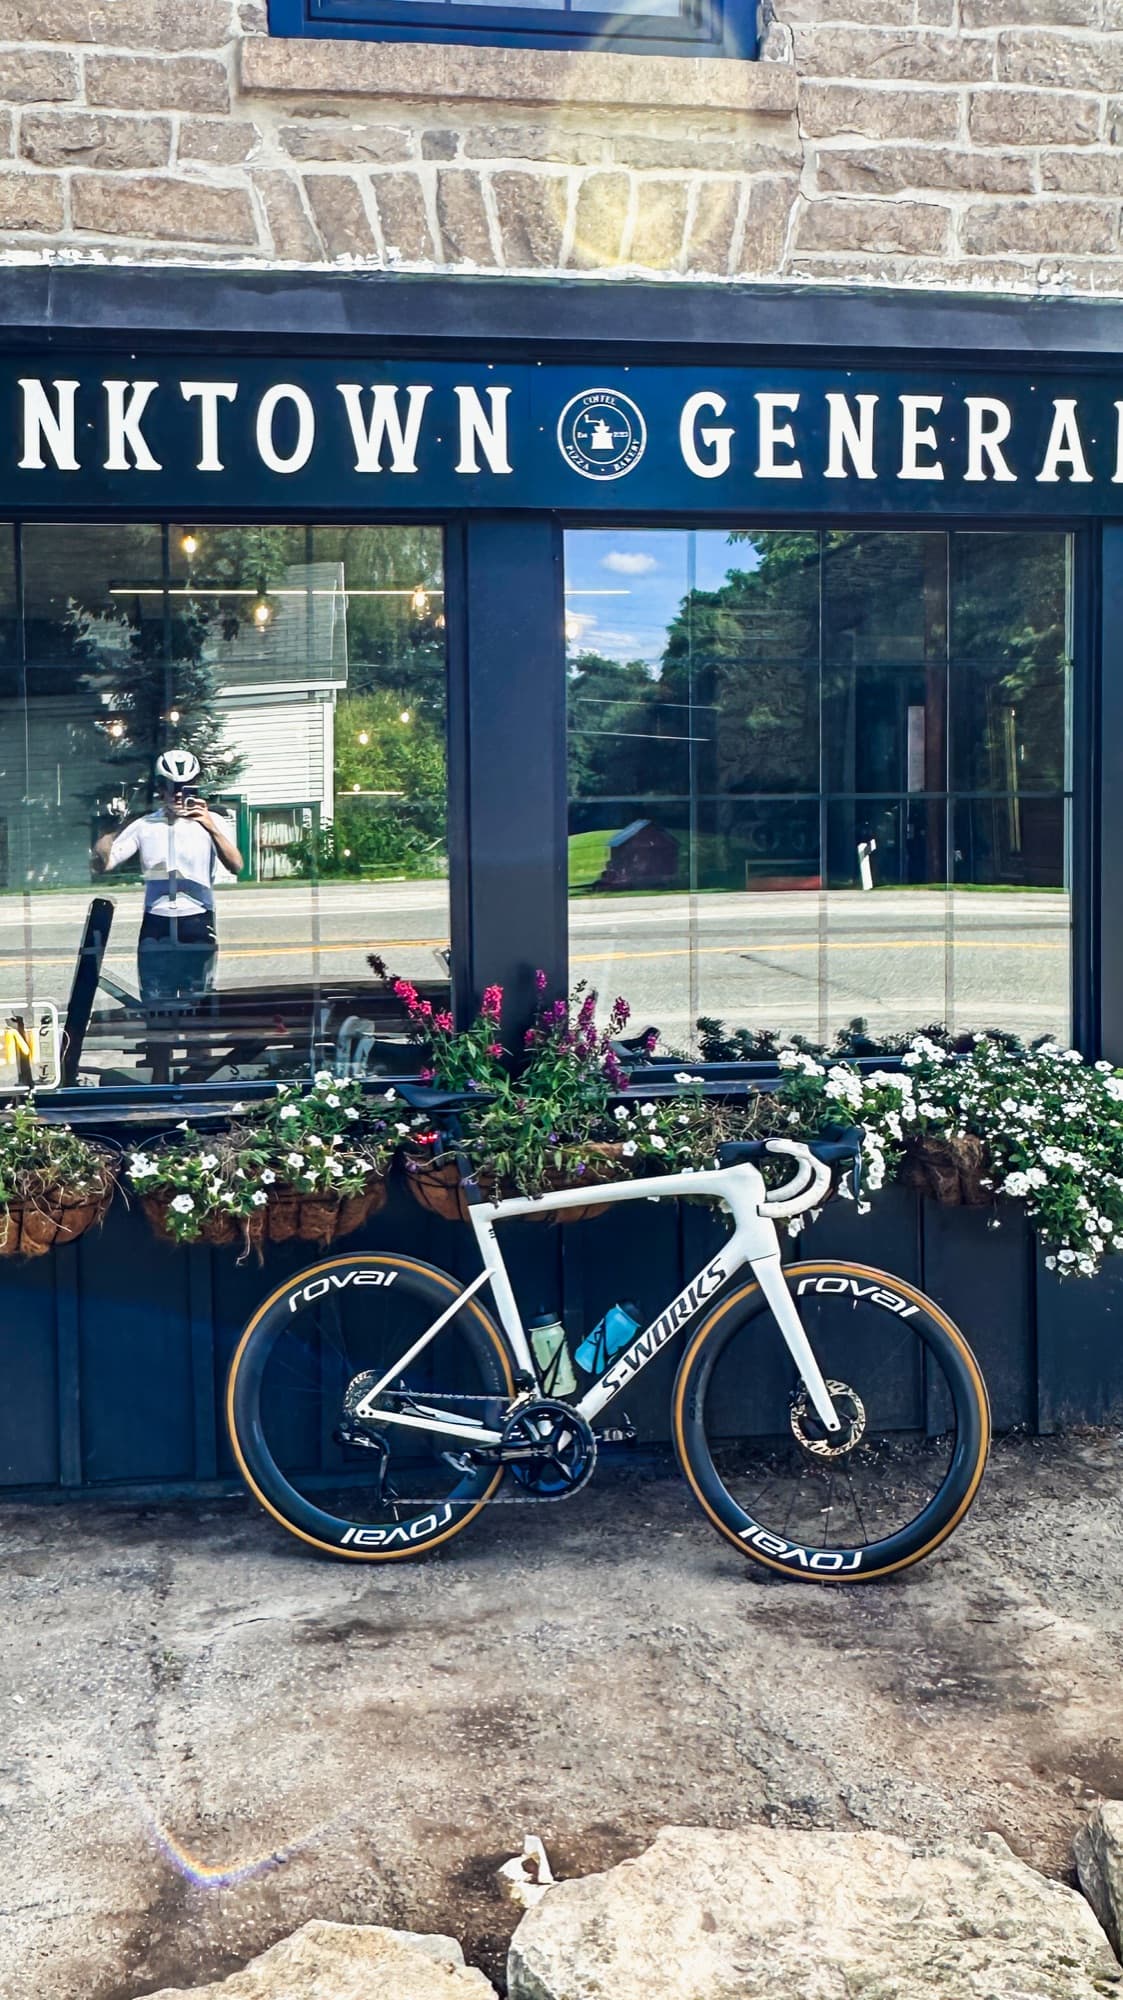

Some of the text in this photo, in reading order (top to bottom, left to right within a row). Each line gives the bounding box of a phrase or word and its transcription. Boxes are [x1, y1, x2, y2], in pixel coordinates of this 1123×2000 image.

[18, 379, 1123, 483] NKTOWN GENERA
[565, 438, 641, 472] PIZZA BAKERY
[288, 1269, 399, 1313] roval
[797, 1277, 920, 1318] roval
[602, 1257, 727, 1401] S-WORKS
[340, 1503, 453, 1546] roval
[739, 1525, 863, 1571] roval
